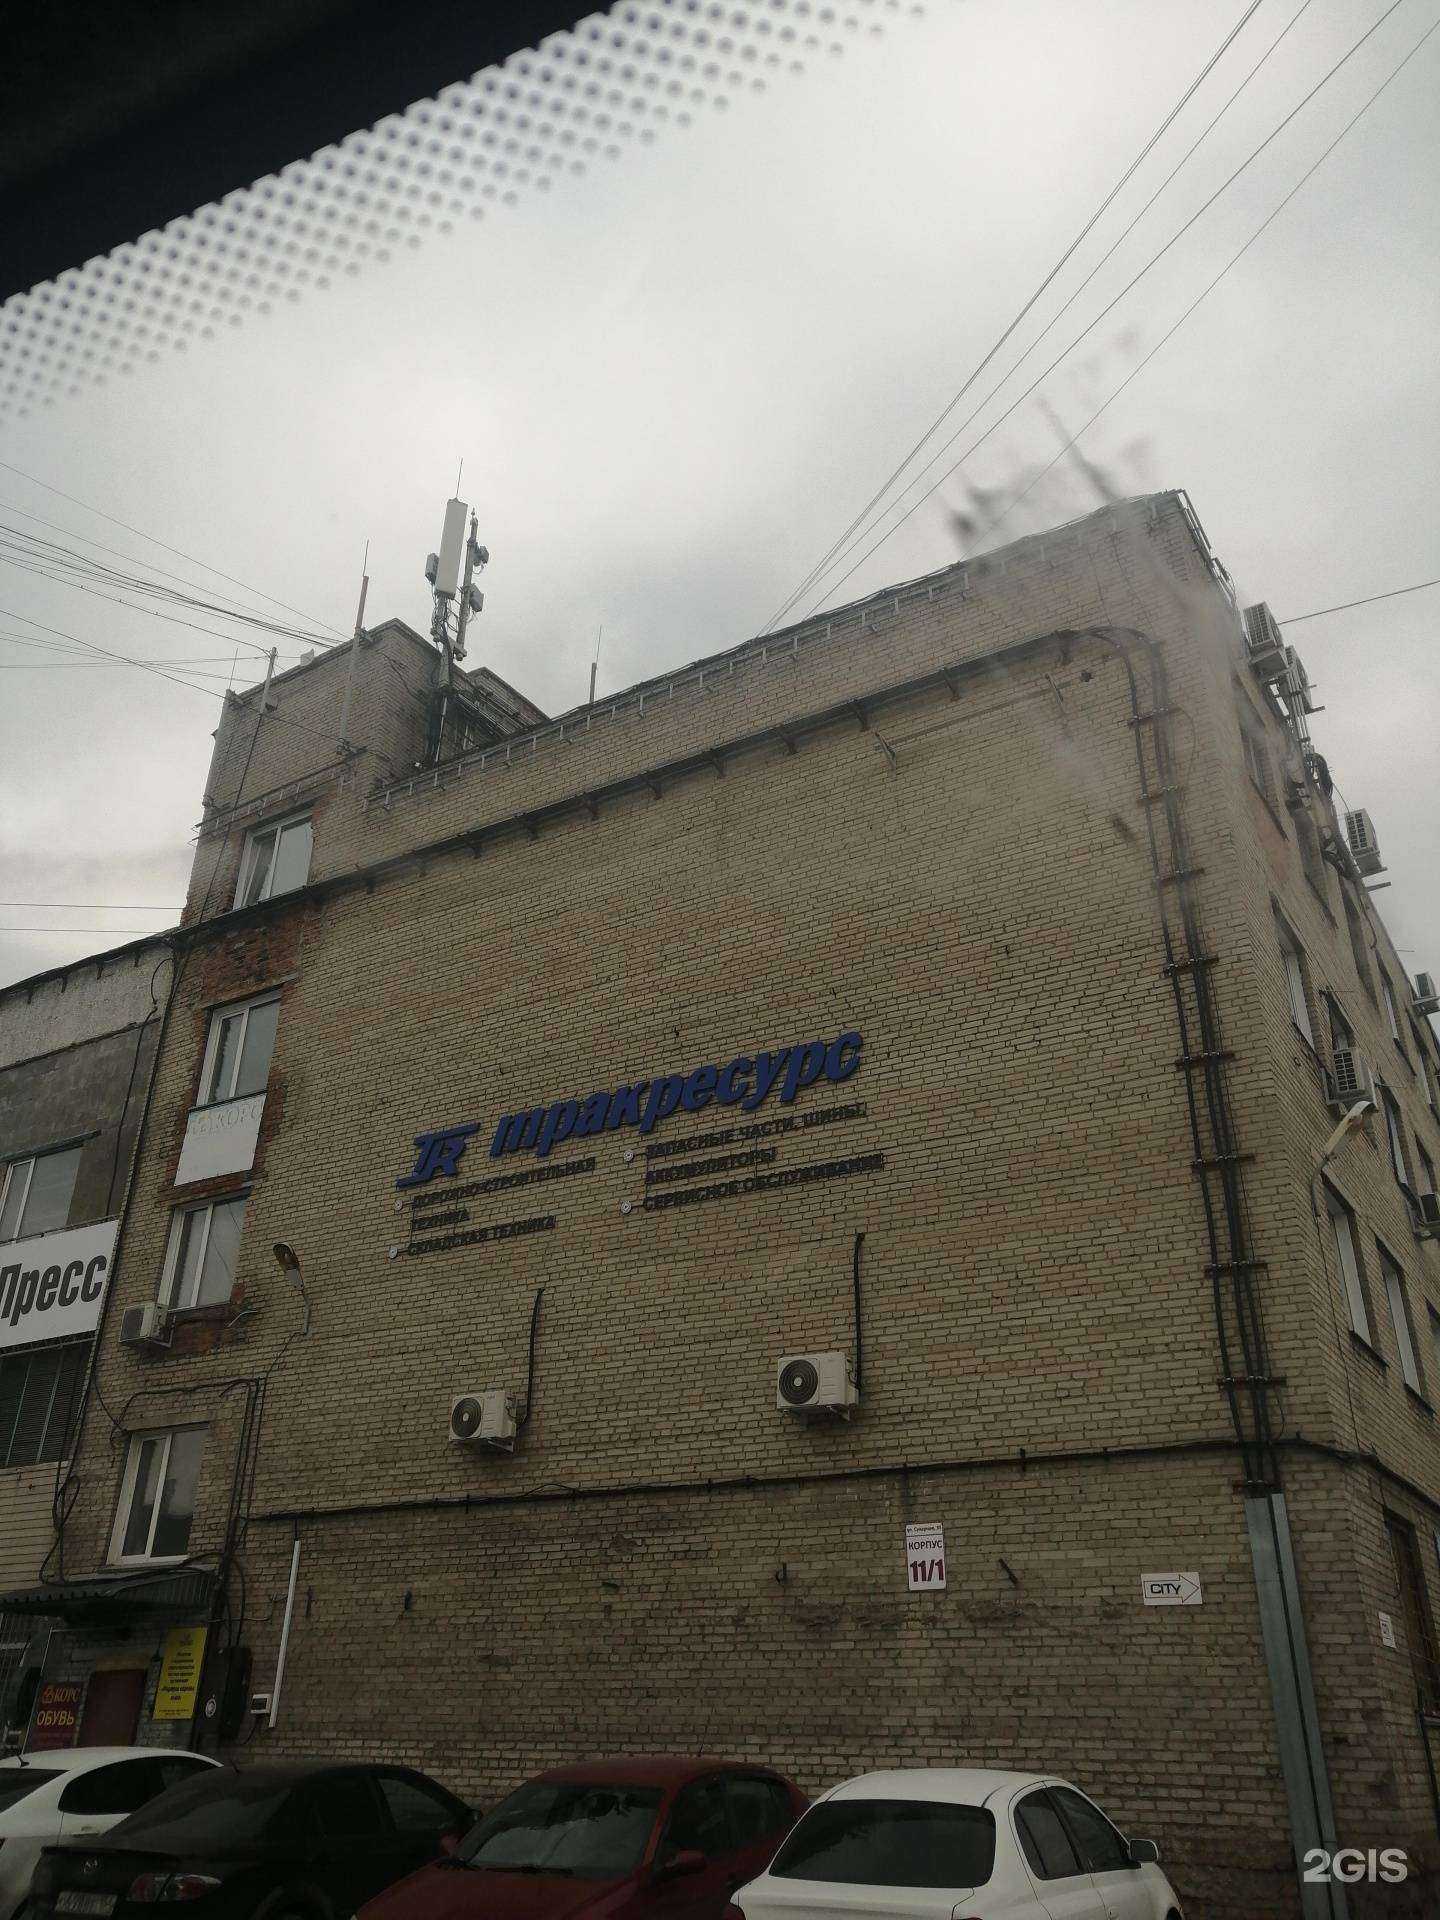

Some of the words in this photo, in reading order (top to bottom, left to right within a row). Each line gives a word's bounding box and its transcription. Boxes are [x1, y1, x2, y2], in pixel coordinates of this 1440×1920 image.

[490, 1031, 864, 1157] тракресурс
[646, 1129, 735, 1158] ЗАПАСНЫЕ
[803, 1102, 867, 1129] ШИНЫ
[908, 1540, 943, 1551] КОРПУС
[910, 1559, 944, 1582] 11/1
[1150, 1583, 1181, 1595] CITY
[37, 1710, 75, 1726] ОБУВЬ
